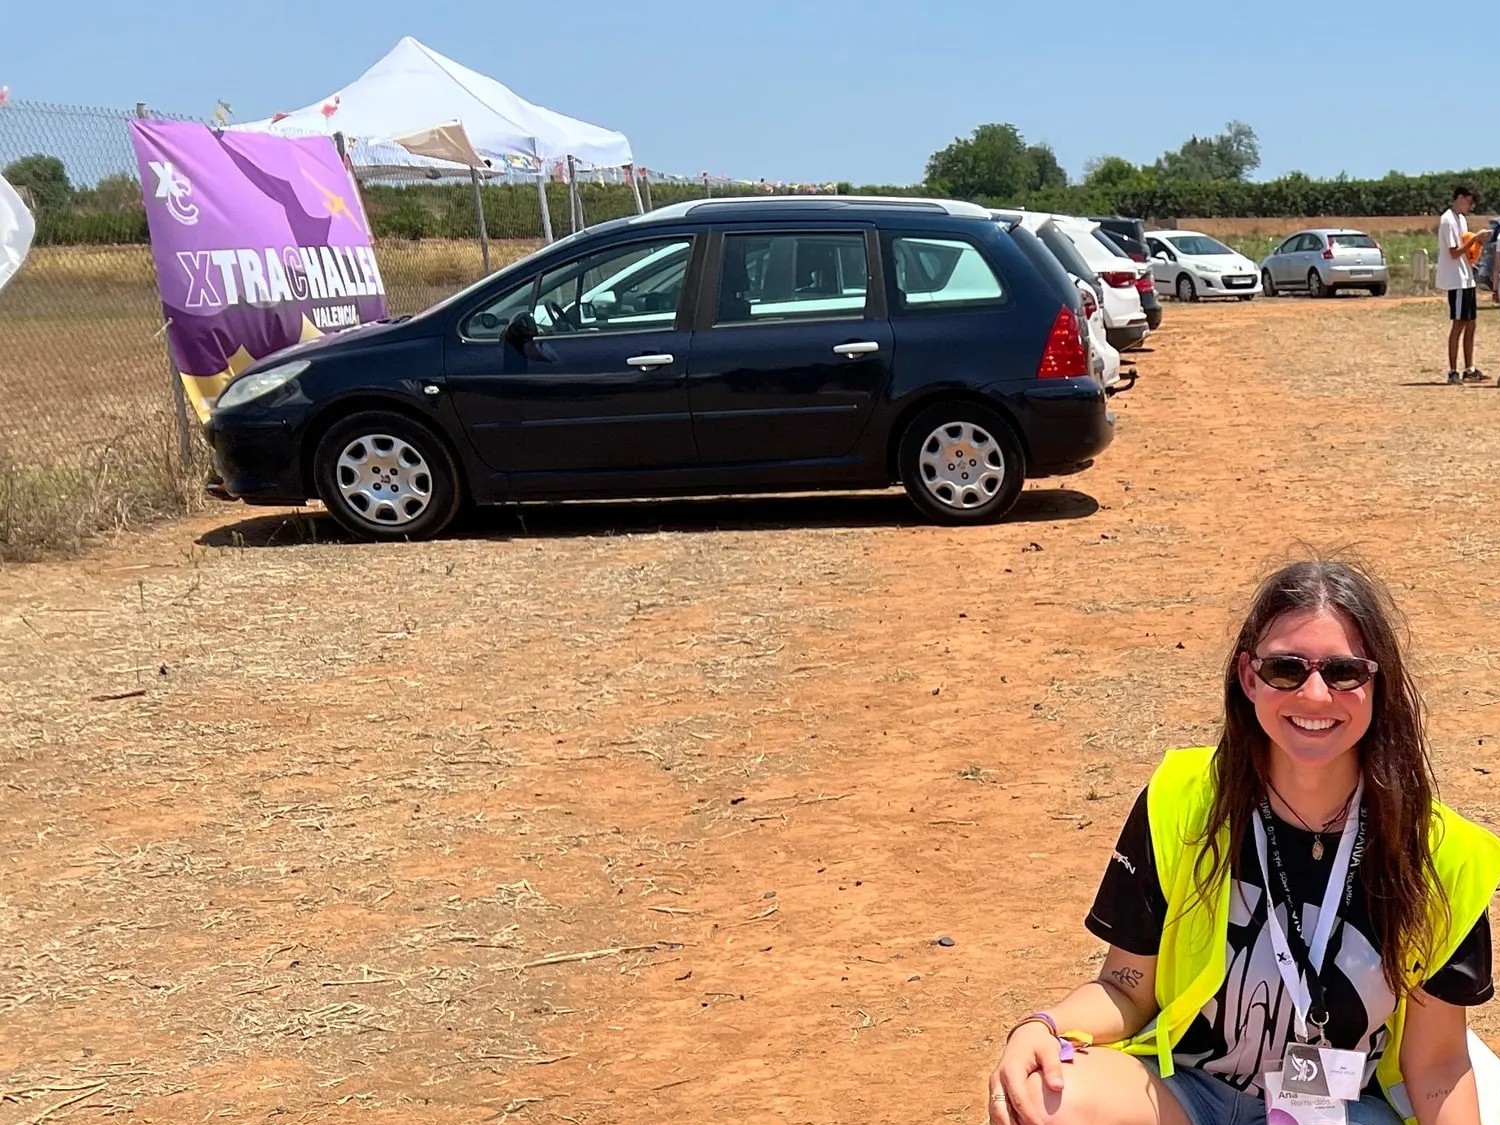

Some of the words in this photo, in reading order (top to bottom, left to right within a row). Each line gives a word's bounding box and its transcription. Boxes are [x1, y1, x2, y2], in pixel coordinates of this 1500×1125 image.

[312, 304, 357, 328] VALENCIA
[1350, 821, 1368, 868] DIANA
[1279, 1091, 1298, 1099] Ana
